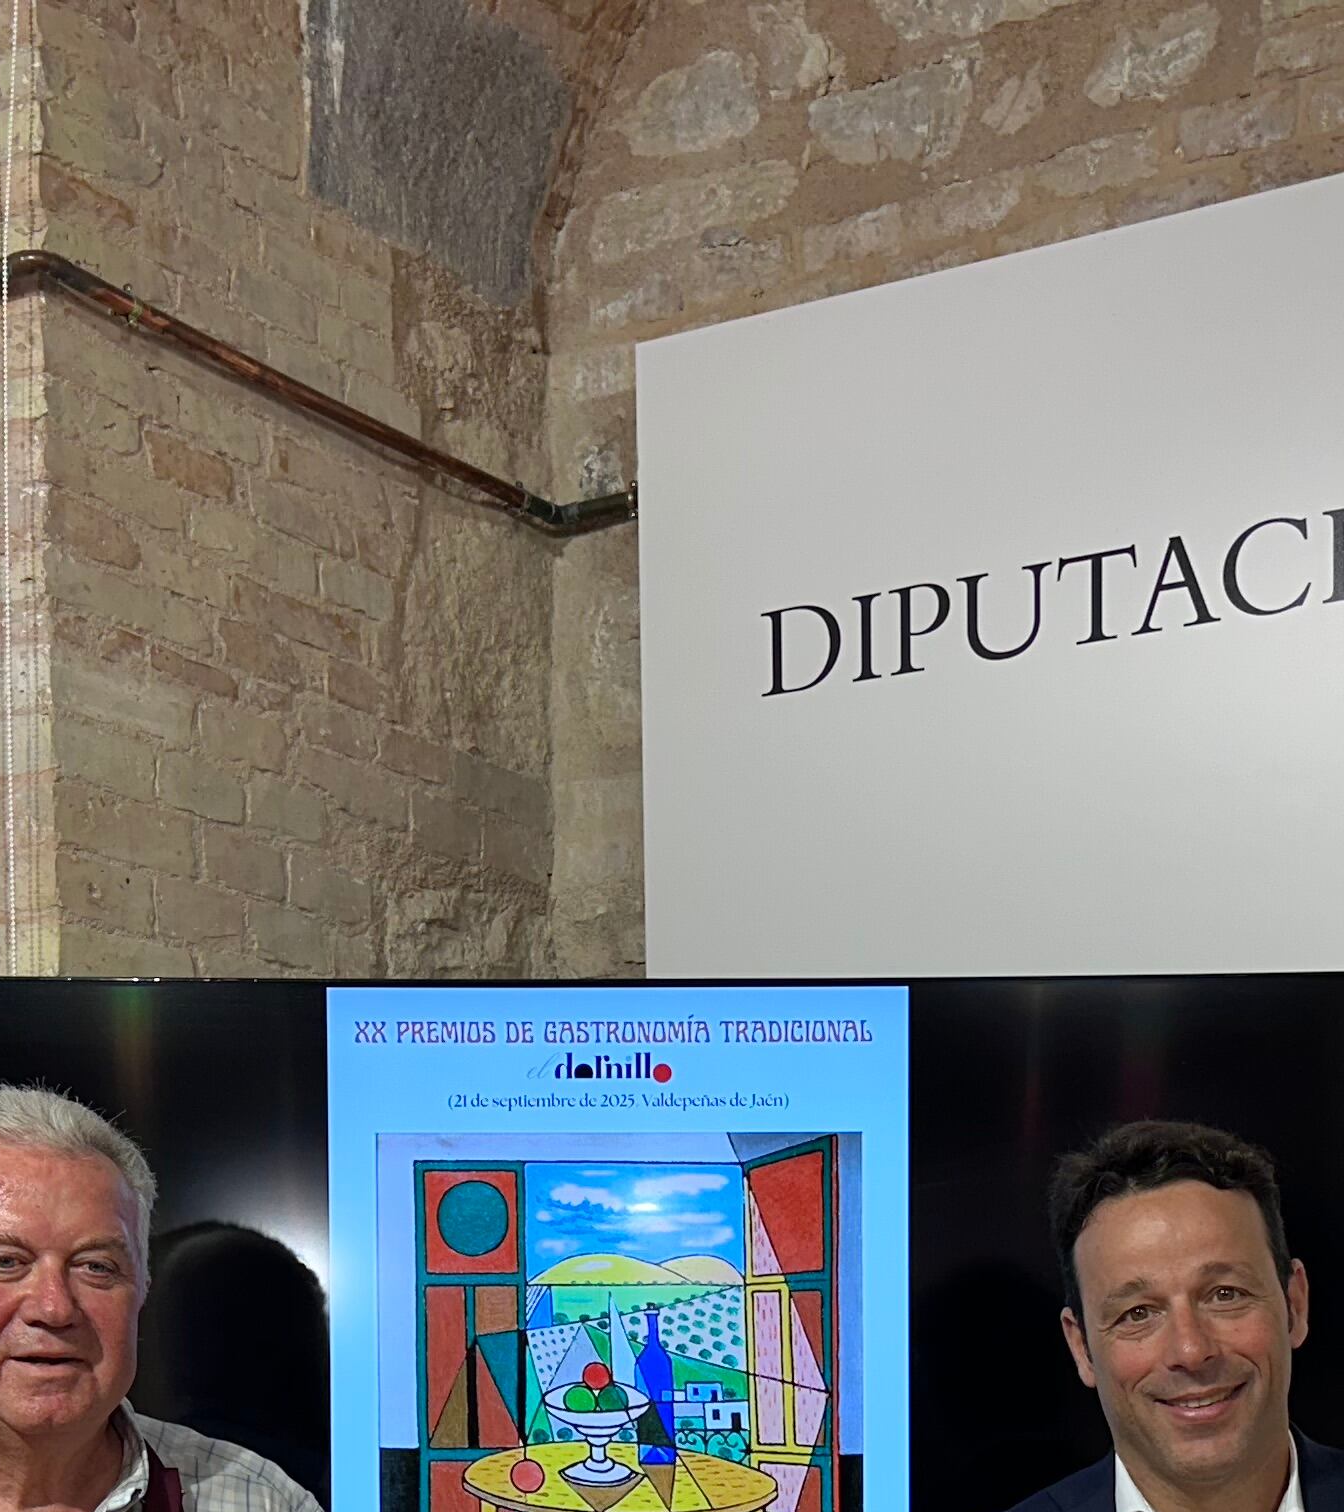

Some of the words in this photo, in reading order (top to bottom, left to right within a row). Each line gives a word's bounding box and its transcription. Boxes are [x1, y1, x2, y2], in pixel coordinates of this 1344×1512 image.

[355, 1021, 387, 1044] XX
[397, 1021, 496, 1044] PREMIOS
[506, 1021, 534, 1043] DE
[544, 1014, 711, 1043] GASTRONOMÍA
[721, 1019, 873, 1043] TRADICIONAL
[471, 1094, 488, 1108] de
[491, 1094, 576, 1110] septiembre
[579, 1094, 597, 1108] de
[642, 1093, 726, 1111] Valdepeñas
[730, 1094, 748, 1108] de
[749, 1093, 790, 1111] Jaén)
